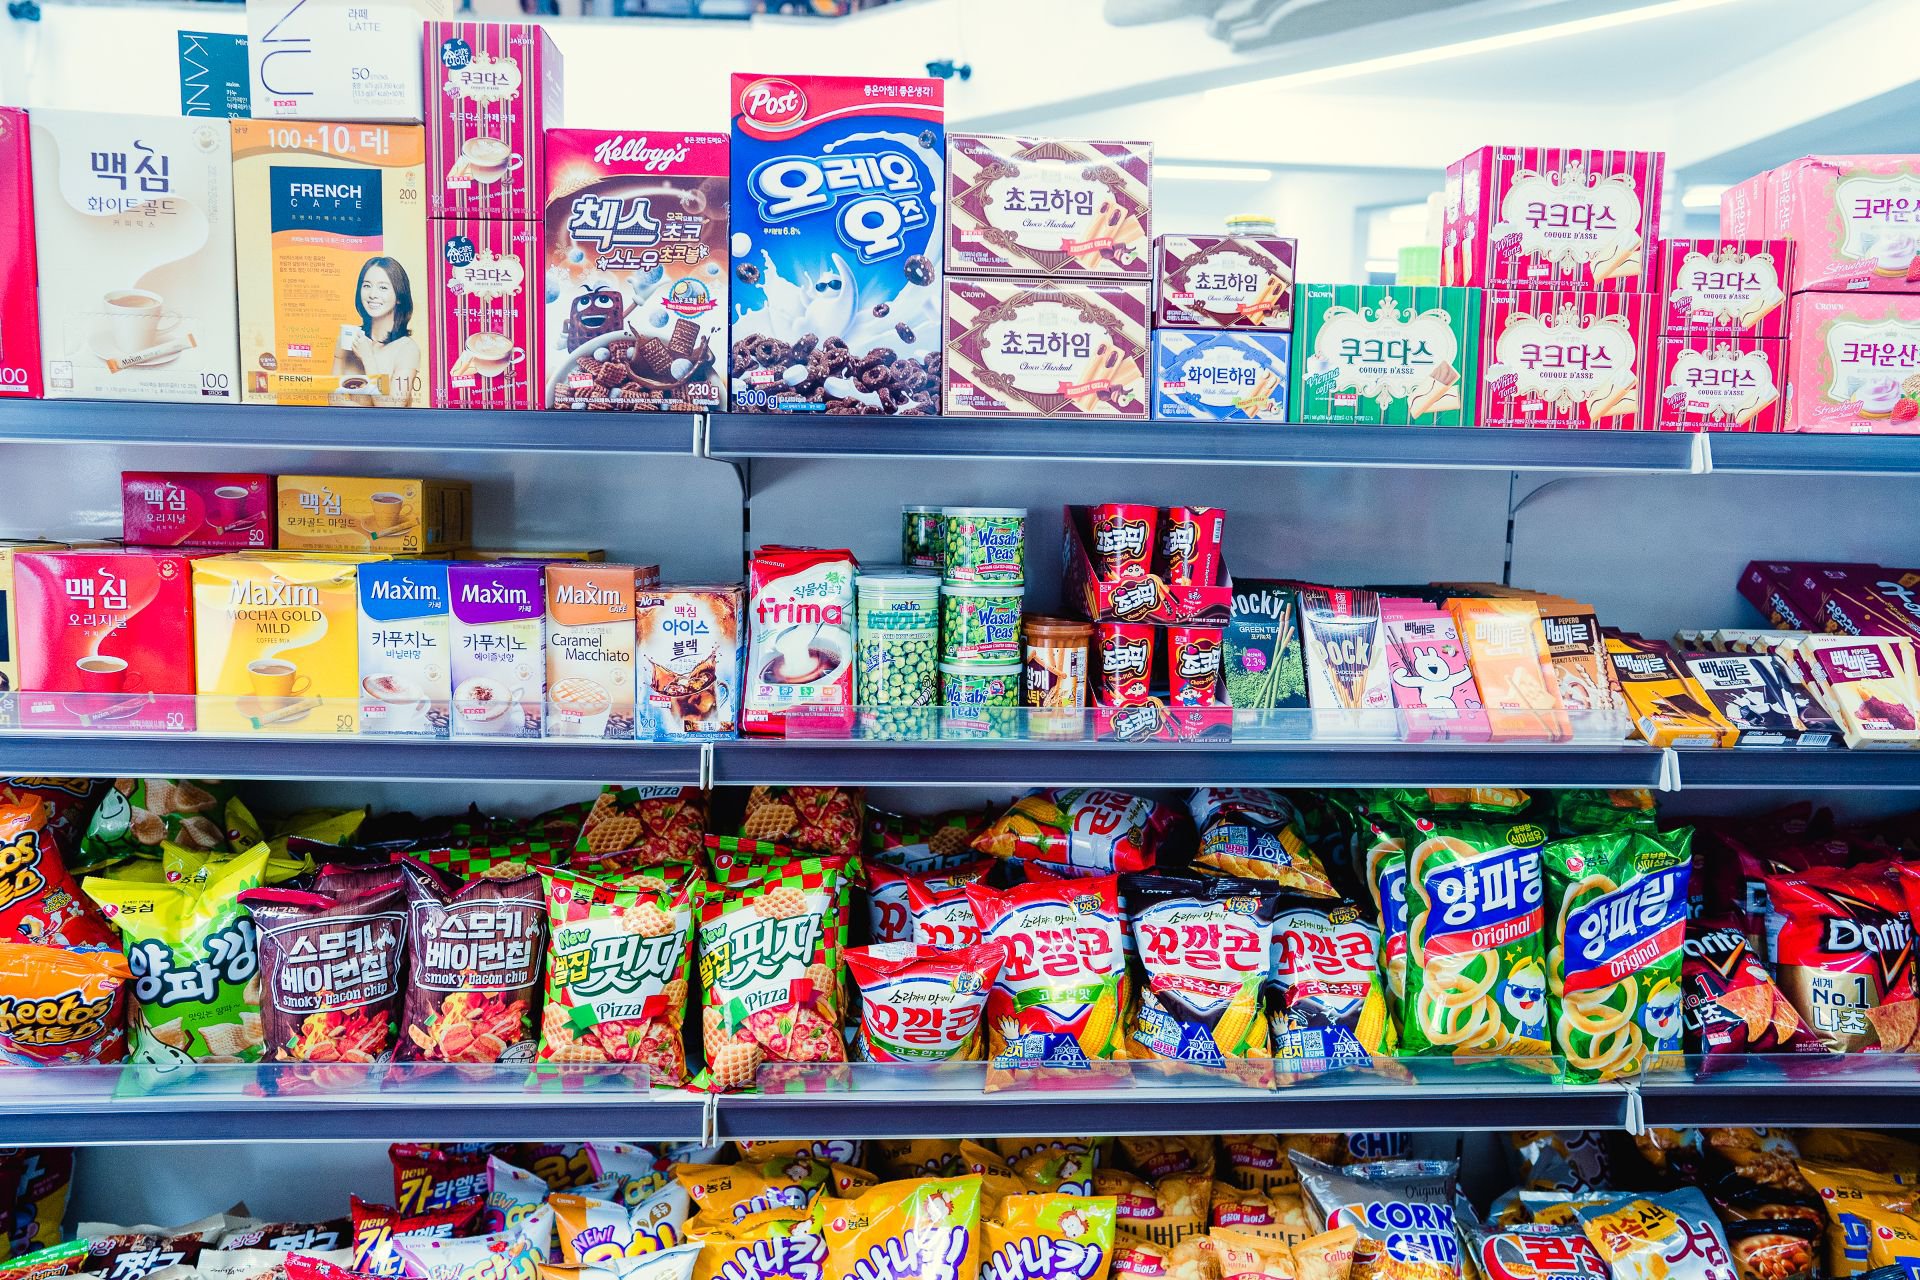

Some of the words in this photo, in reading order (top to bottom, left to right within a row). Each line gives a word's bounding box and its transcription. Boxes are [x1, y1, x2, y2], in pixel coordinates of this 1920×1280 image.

[349, 22, 381, 31] LATTE
[351, 67, 370, 80] 50
[460, 71, 510, 86] 쿠크다스
[864, 85, 898, 97] 좋은아침!
[899, 86, 934, 98] 좋은생각!
[748, 88, 799, 115] Post
[594, 135, 690, 171] Kellogg's
[90, 140, 173, 193] 맥심
[290, 183, 362, 199] FRENCH
[757, 154, 919, 215] 오레오
[399, 188, 417, 200] 200
[1004, 187, 1094, 216] 쵸코하임
[87, 196, 177, 216] 화이트골드
[290, 199, 362, 209] CAFE
[569, 194, 659, 251] 첵스
[1525, 202, 1617, 231] 쿠크다스
[661, 222, 704, 242] 초코
[1543, 231, 1572, 239] COUQUE
[1573, 232, 1598, 240] D'ASSE
[1495, 232, 1523, 252] White
[606, 250, 658, 271] 스노우
[659, 245, 701, 264] 초코볼
[1823, 257, 1879, 275] Strawberry
[465, 268, 513, 282] 쿠크다스
[1195, 272, 1258, 292] 쵸코하임
[1692, 271, 1761, 291] 쿠크다스
[961, 290, 986, 298] CROWN
[1308, 290, 1333, 298] CROWN
[1815, 303, 1844, 311] CROWN
[1001, 330, 1091, 358] 쵸코하임
[1339, 338, 1433, 365] 쿠크다스
[1520, 344, 1613, 370] 쿠크다스
[278, 375, 313, 383] FRENCH
[1187, 366, 1256, 386] 화이트하임
[1306, 367, 1340, 388] Vienna
[1359, 366, 1388, 374] COUQUE
[1390, 367, 1415, 375] D'ASSE
[1539, 371, 1568, 379] COUQUE
[1686, 368, 1756, 388] 쿠크다스
[200, 373, 228, 388] 100
[395, 376, 422, 392] 110
[1315, 380, 1337, 395] coffee
[1491, 373, 1519, 392] White
[688, 384, 710, 396] 230
[736, 390, 767, 406] 500
[1812, 400, 1865, 418] Strawberry
[144, 482, 188, 511] 맥심
[299, 487, 343, 515] 맥심
[146, 513, 187, 524] 오리지날
[287, 517, 326, 527] 모카골드
[328, 518, 357, 528] 마일드
[249, 529, 265, 542] 50
[402, 535, 418, 547] 50
[978, 526, 1019, 547] Wasabi
[986, 546, 1014, 564] Peas
[65, 567, 128, 610] 맥심
[228, 576, 321, 606] Maxim
[371, 577, 440, 600] Maxim
[461, 580, 531, 604] Maxim
[556, 581, 624, 605] Maxim
[793, 582, 828, 598] 식물성
[674, 602, 697, 618] 맥심
[891, 601, 920, 611] KABUTO
[68, 613, 128, 629] 오리지날
[227, 609, 278, 621] MOCHA
[281, 611, 322, 622] GOLD
[256, 623, 290, 634] MILD
[662, 619, 709, 636] 아이스
[986, 625, 1014, 643] Peas
[1404, 621, 1435, 635] 빼빼로
[372, 630, 437, 648] 카푸치노
[463, 634, 527, 652] 카푸치노
[552, 633, 602, 647] Caramel
[672, 639, 699, 656] 블랙
[474, 652, 515, 663] 헤이즐넛향
[565, 648, 630, 662] Macchiato
[1245, 657, 1266, 667] 2.3%
[1829, 649, 1882, 673] 빼빼로
[1613, 654, 1667, 675] 빼빼로
[1699, 660, 1751, 681] 빼빼로
[946, 684, 987, 704] Wasabi
[1369, 695, 1384, 704] Real
[166, 713, 184, 725] 50
[951, 701, 980, 720] Peas
[336, 714, 353, 727] 50
[640, 785, 681, 798] Pizza
[1509, 832, 1543, 846] 식이섬유
[1437, 853, 1544, 925] 양파링
[121, 902, 154, 915] 농심
[1229, 901, 1256, 914] 1983
[1578, 873, 1676, 960] 양파링
[440, 910, 522, 940] 스모키
[1471, 920, 1531, 948] Original
[287, 924, 374, 964] 스모키
[558, 928, 590, 949] New
[700, 924, 727, 949] New
[425, 939, 532, 972] 베이컨칩
[720, 913, 824, 990] 핏자
[1000, 927, 1113, 982] 꼬깔콘
[1140, 924, 1262, 973] 꼬깔콘
[1271, 930, 1377, 976] 꼬깔콘
[129, 917, 258, 1003] 양파깡
[554, 950, 592, 986] 벌집
[573, 931, 687, 997] 핏자
[1609, 940, 1661, 978] Original
[281, 951, 388, 995] 베이컨칩
[424, 972, 465, 987] smoky
[468, 971, 503, 985] bacon
[505, 971, 528, 985] chip
[1305, 983, 1363, 997] 군옥수수맛
[1812, 977, 1833, 989] 세계
[283, 993, 323, 1009] smoky
[325, 989, 362, 1007] bacon
[364, 982, 388, 998] chip
[744, 986, 788, 1010] Pizza
[1813, 976, 1871, 1009] No.1
[596, 1001, 642, 1020] Pizza
[862, 1002, 982, 1044] 꼬깔콘
[1814, 1008, 1869, 1034] 나쵸
[401, 1168, 427, 1179] new
[706, 1181, 732, 1193] 농심
[1404, 1182, 1447, 1202] Original
[1133, 1206, 1155, 1216] 들어간
[1367, 1202, 1455, 1230] CORN
[359, 1217, 389, 1231] new
[848, 1217, 869, 1230] 농심
[573, 1225, 615, 1252] NEW!
[1133, 1264, 1157, 1273] 들어간
